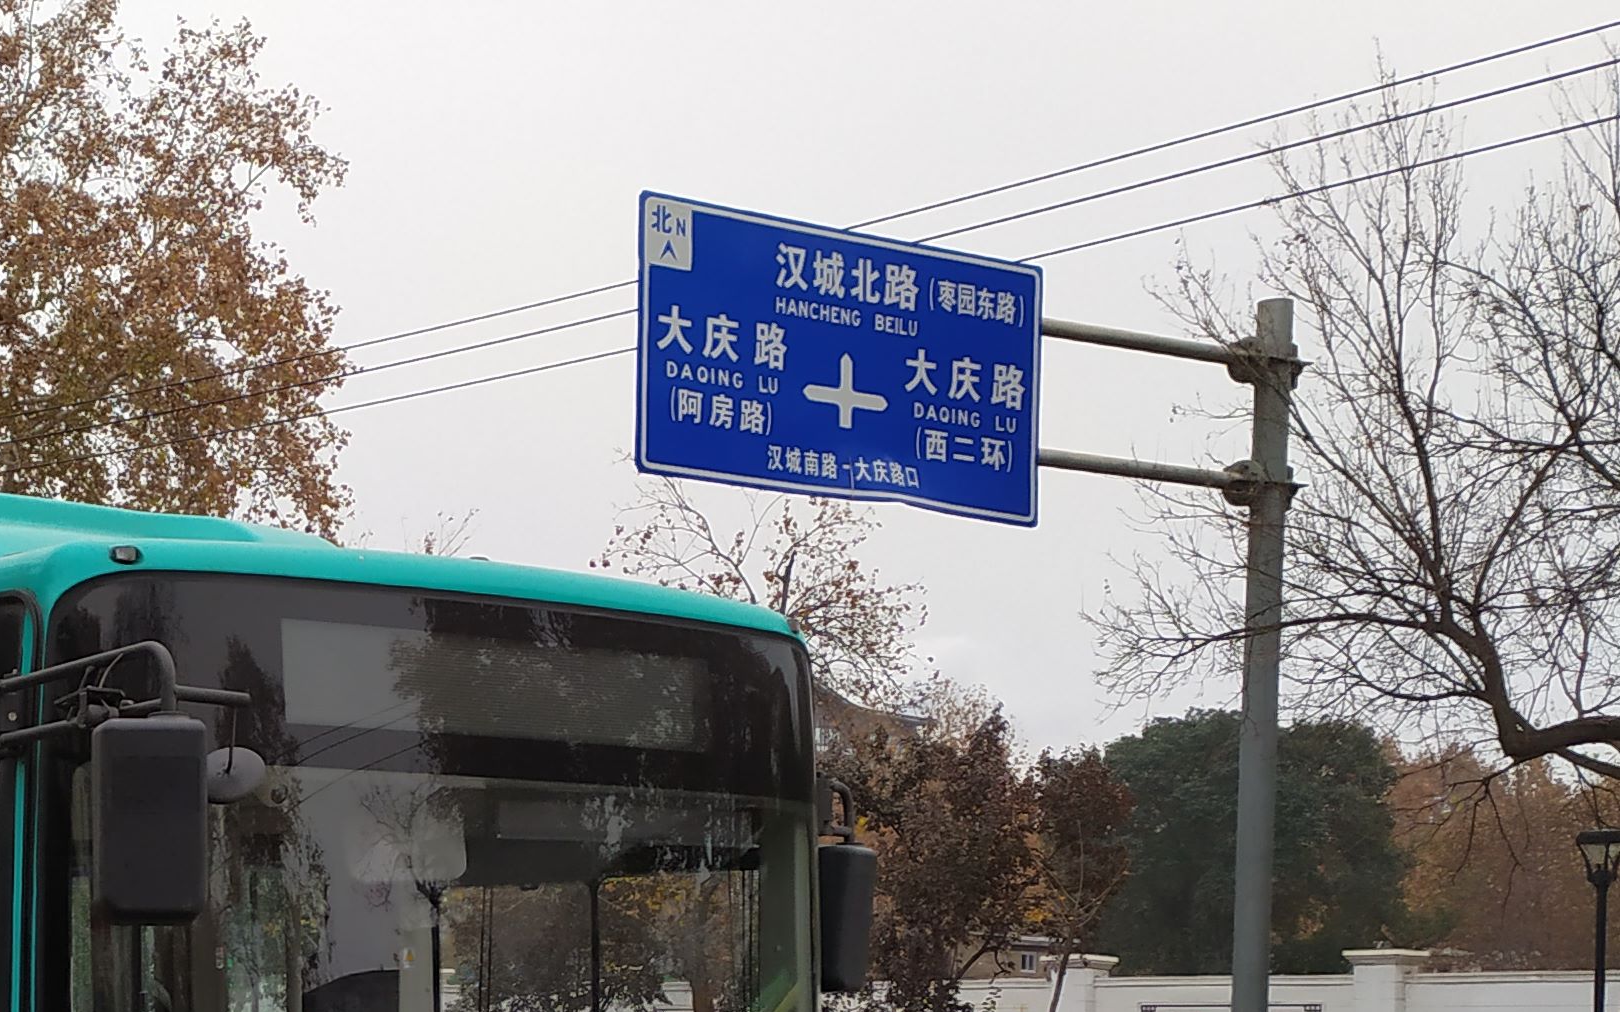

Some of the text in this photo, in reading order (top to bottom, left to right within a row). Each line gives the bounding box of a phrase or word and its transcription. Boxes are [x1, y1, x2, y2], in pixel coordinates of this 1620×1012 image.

[651, 204, 686, 237] 北 N
[776, 242, 920, 313] 汉城北路
[656, 304, 788, 371] 大庆路
[775, 296, 918, 338] HANCHENG BEILU
[666, 360, 779, 395] DAQING LU
[904, 348, 1026, 411] 大庆路
[670, 386, 773, 437] (阿房路)
[913, 401, 1017, 434] DAQING LU
[915, 426, 1013, 473] (西二环)
